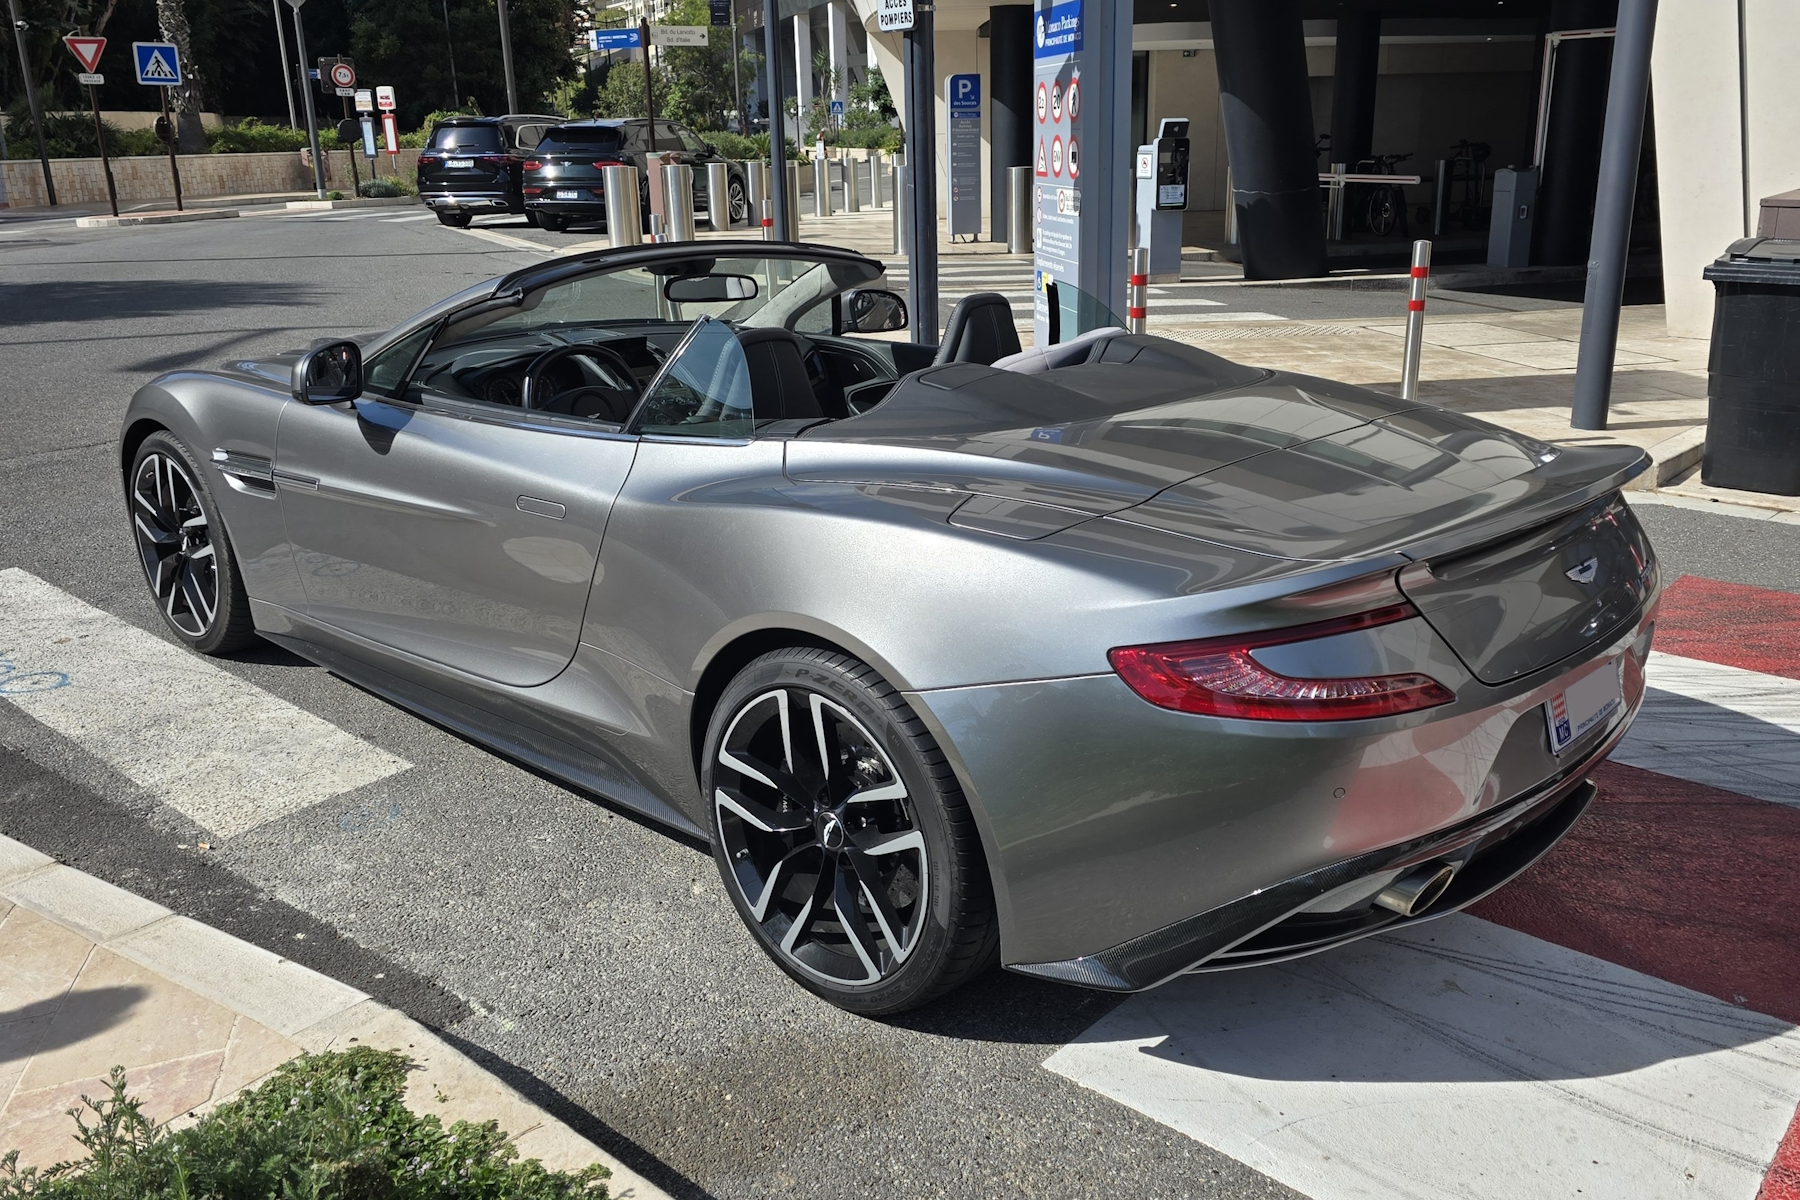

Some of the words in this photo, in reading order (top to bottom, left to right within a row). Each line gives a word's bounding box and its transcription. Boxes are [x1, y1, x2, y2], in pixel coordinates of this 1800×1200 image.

[881, 11, 912, 26] POMPIERS
[959, 80, 972, 99] P
[1558, 722, 1569, 741] MC
